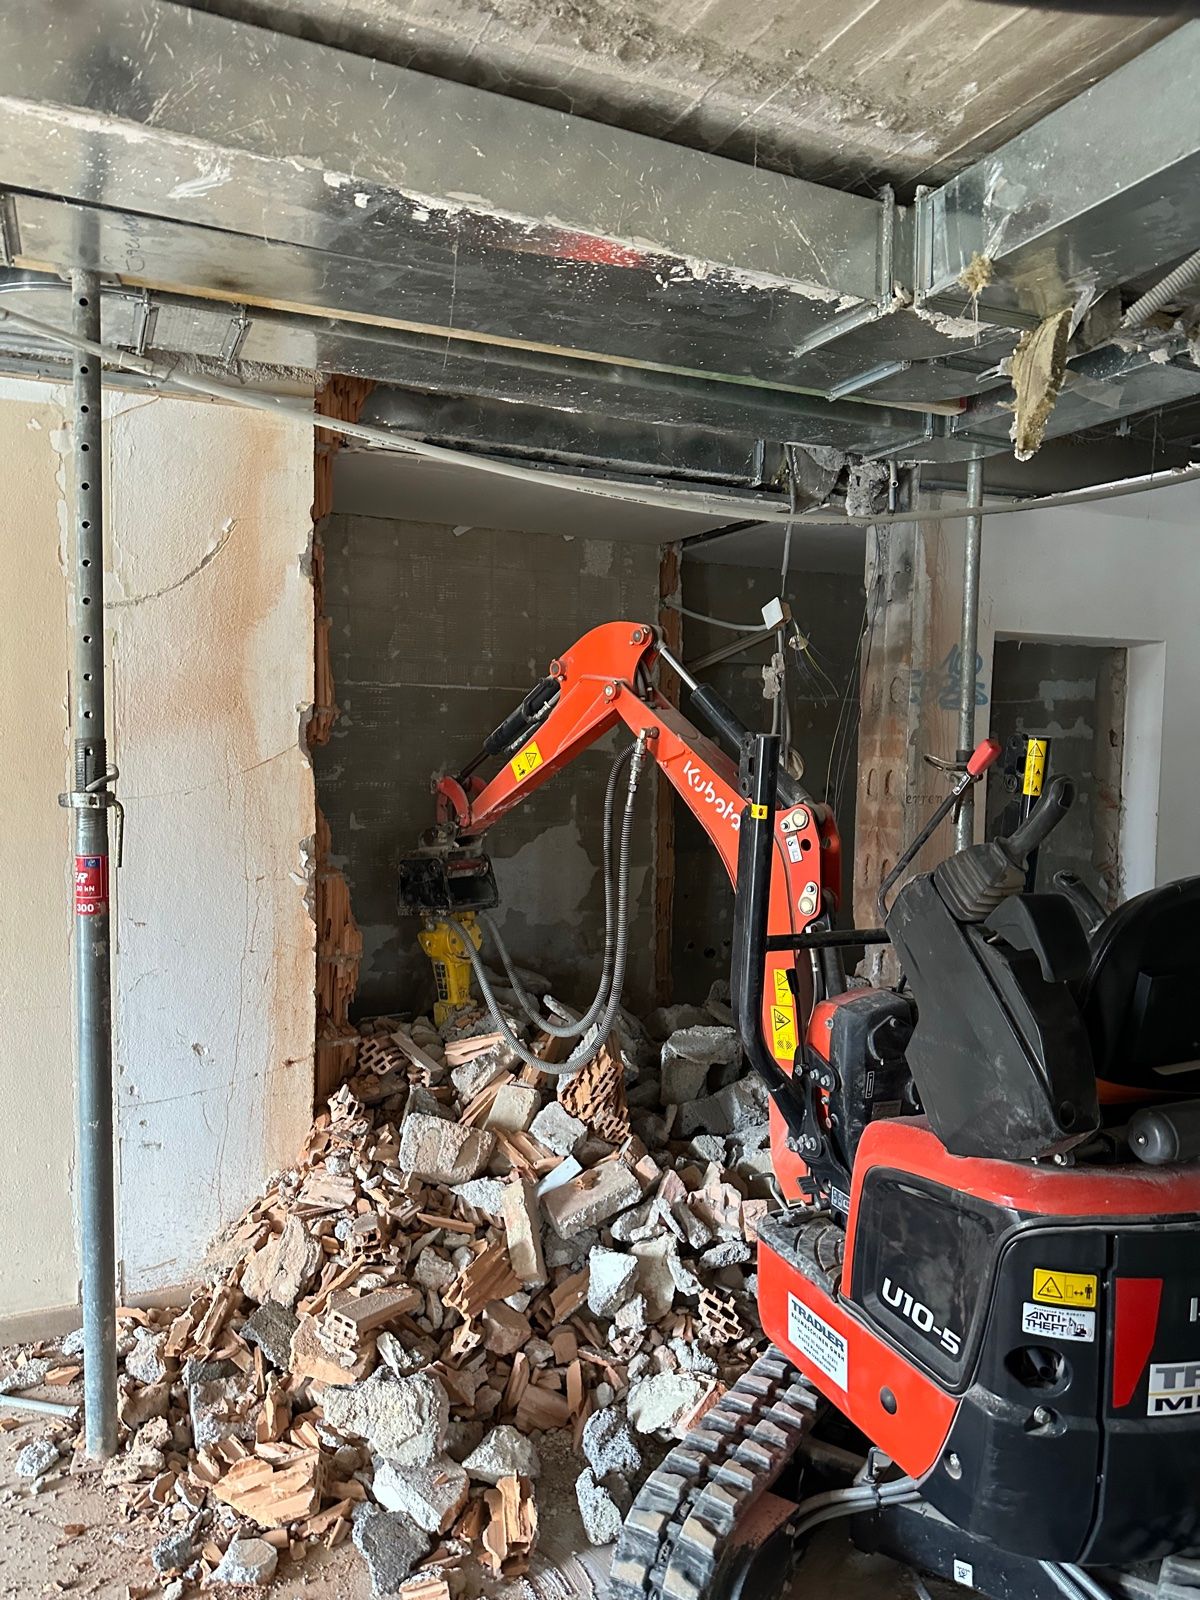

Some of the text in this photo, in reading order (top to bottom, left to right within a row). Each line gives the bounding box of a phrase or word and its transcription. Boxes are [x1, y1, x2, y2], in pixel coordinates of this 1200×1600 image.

[683, 760, 741, 831] Kubota
[791, 1299, 844, 1353] TRADLER
[882, 1277, 962, 1356] U10-5
[1025, 1317, 1067, 1332] THEFT
[1026, 1311, 1061, 1323] ANTI
